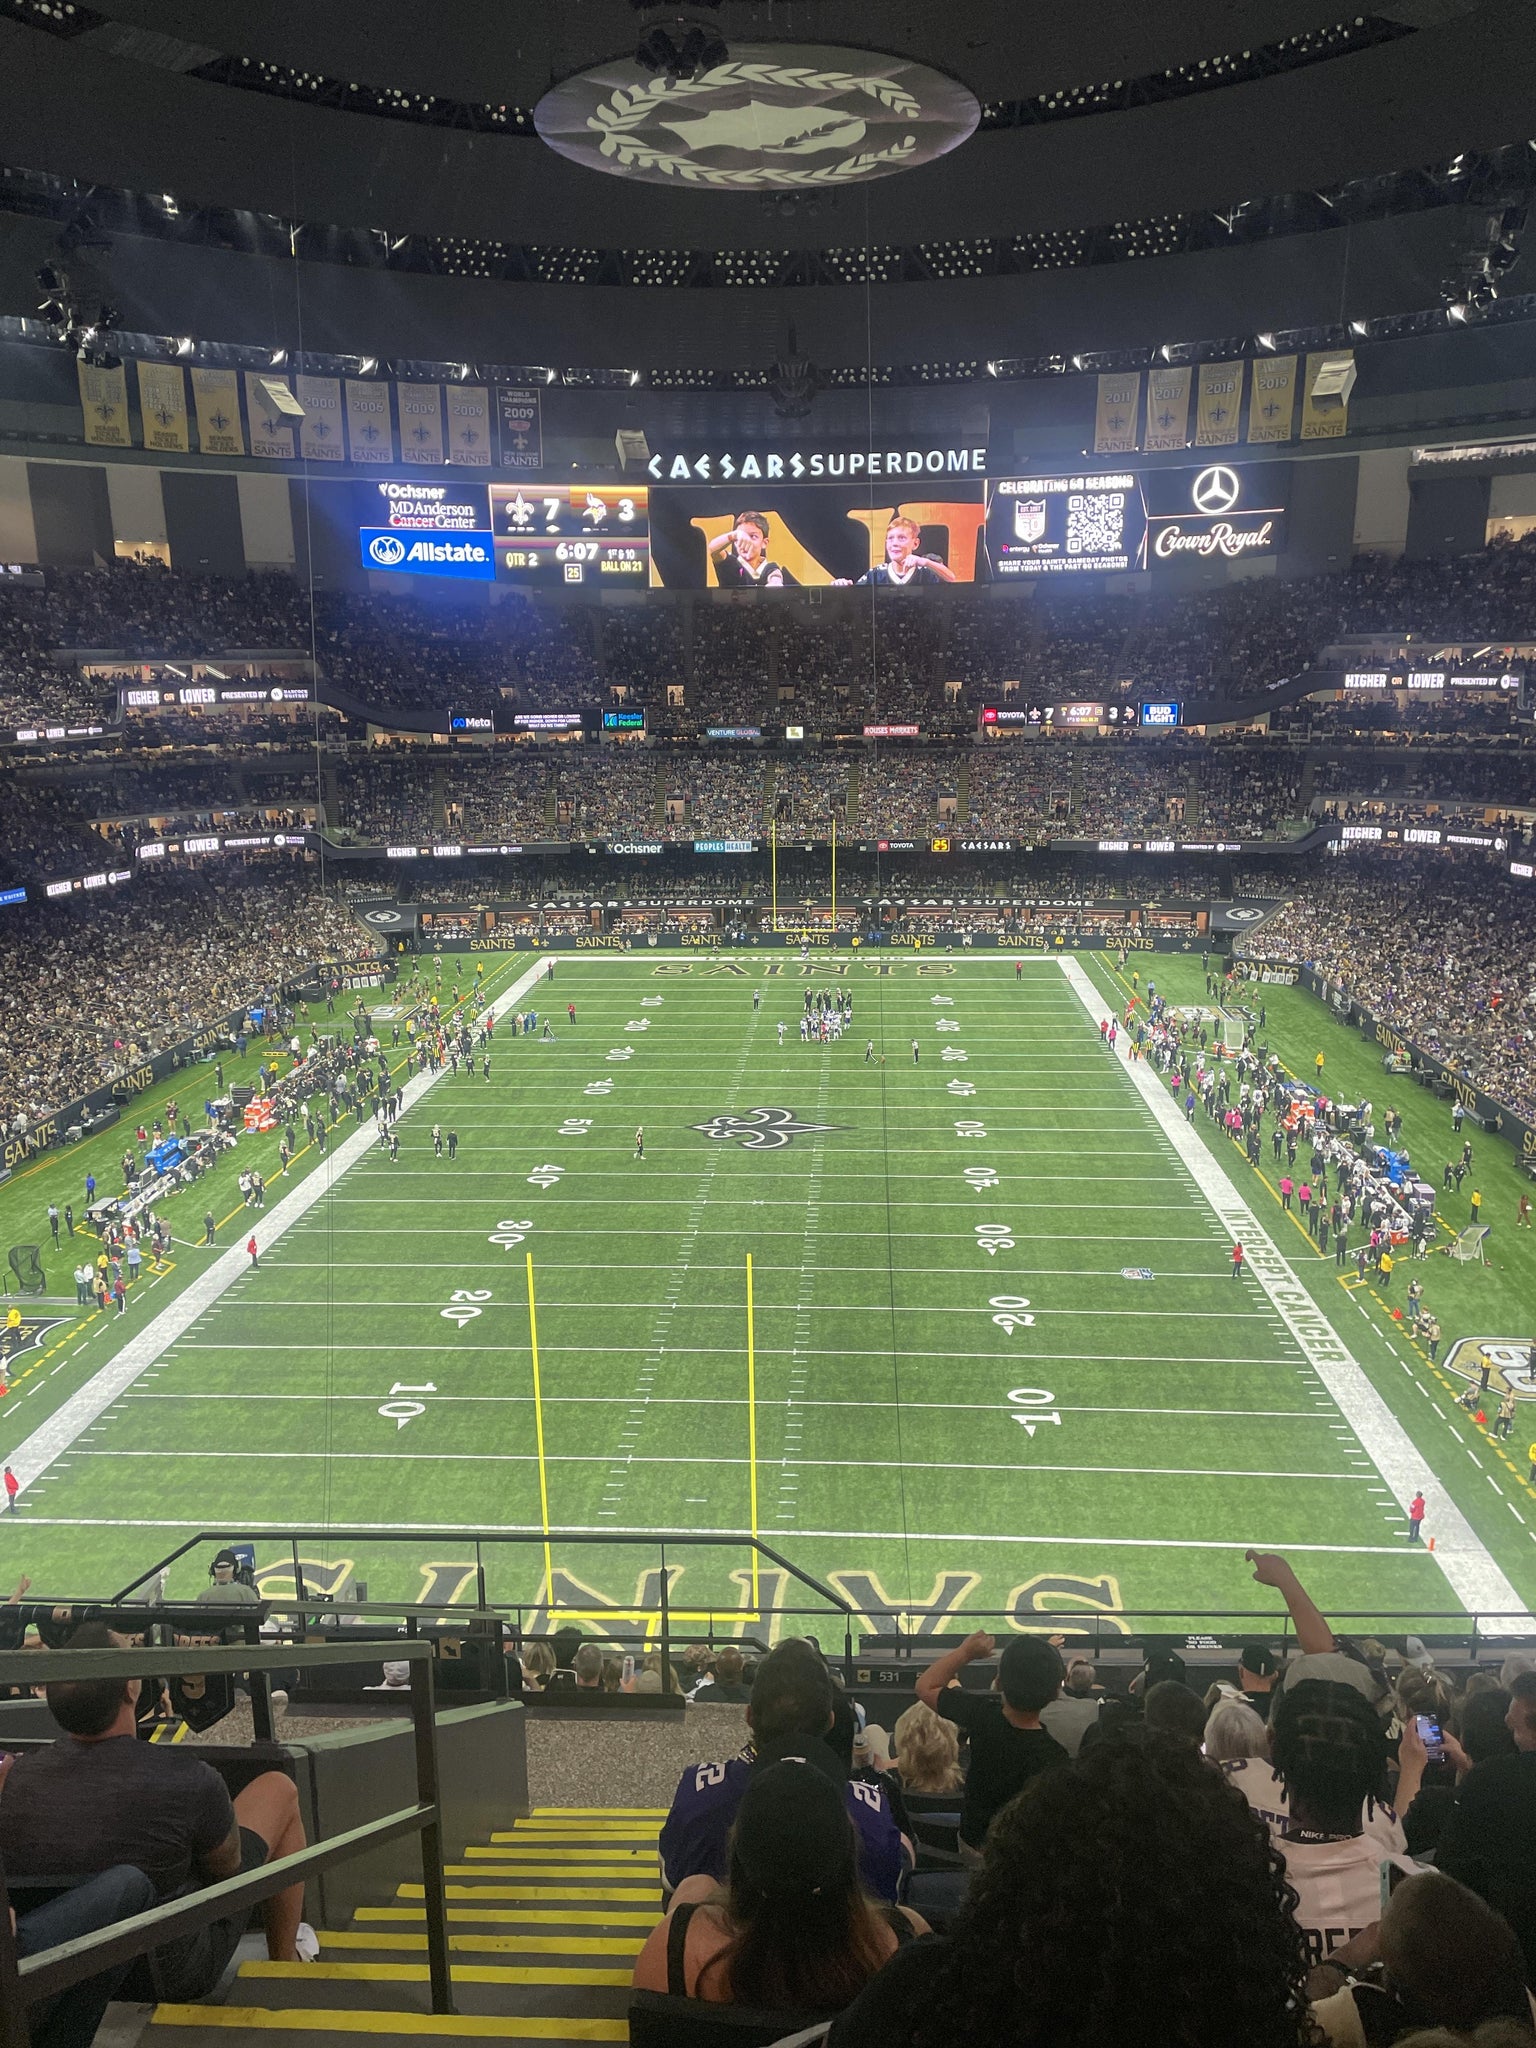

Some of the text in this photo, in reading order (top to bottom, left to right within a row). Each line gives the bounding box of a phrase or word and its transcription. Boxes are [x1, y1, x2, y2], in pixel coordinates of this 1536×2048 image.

[1206, 382, 1235, 394] 2018
[1259, 377, 1289, 390] 2019
[1105, 392, 1131, 404] 2011
[1156, 388, 1183, 400] 2017
[304, 396, 336, 409] 2000
[504, 407, 535, 419] 2009
[1250, 429, 1289, 441] SAINTS
[1304, 426, 1343, 437] SAINTS
[1147, 439, 1183, 449] SAINTS
[1198, 433, 1237, 445] SAINTS
[254, 445, 291, 457] SAINTS
[1097, 441, 1132, 451] SAINTS
[305, 448, 341, 459] SAINTS
[353, 451, 390, 461] SAINTS
[404, 452, 440, 463] SAINTS
[453, 454, 488, 464] SAINTS
[503, 456, 539, 466] SAINTS
[648, 449, 986, 479] CAESARS SUPERDOME
[999, 479, 1068, 494] CELEBRATING
[1086, 475, 1133, 490] SEASONS
[388, 484, 445, 500] Ochsner
[390, 501, 474, 516] MD Anderson
[543, 498, 634, 521] 7 3
[390, 515, 476, 529] Cancer Center
[1155, 525, 1214, 557] Crown
[555, 542, 599, 560] 6:07
[626, 549, 635, 559] 10
[506, 552, 538, 567] QTR 2
[601, 561, 642, 572] BALL ON 21
[567, 567, 579, 579] 25
[1345, 673, 1498, 688] HIGHER OR LOWER PRESENTED BY
[164, 692, 175, 701] OR
[180, 688, 215, 704] LOWER
[221, 691, 257, 700] PRESENTED
[1045, 707, 1054, 719] 7
[1070, 706, 1092, 716] 6:07
[1109, 706, 1118, 719] 3
[1150, 706, 1170, 715] BUD
[466, 717, 490, 728] Meta
[1146, 714, 1175, 723] LIGHT
[865, 726, 918, 735] ROUSES MARKETS
[1342, 827, 1382, 839] HIGHER
[1404, 829, 1440, 843] LOWER
[1447, 835, 1483, 846] PRESENTED
[1484, 838, 1492, 846] BY
[169, 844, 179, 852] OR
[184, 838, 219, 853] LOWER
[224, 838, 260, 847] PRESENTED
[261, 837, 270, 845] BY
[614, 843, 662, 854] Ochsner
[695, 843, 751, 851] PEOPLES HEALTH
[934, 840, 948, 851] 25
[961, 842, 1011, 850] CAESARS
[1020, 839, 1047, 847] SAINTS
[1099, 842, 1129, 851] HIGHER
[1146, 842, 1175, 852] LOWER
[387, 847, 417, 857] HIGHER
[433, 846, 461, 856] LOWER
[83, 874, 107, 888] LOWER
[528, 899, 755, 908] CAESARS SUPERDOME
[862, 898, 1095, 907] CAESARS SUPERDOME
[471, 939, 516, 950] SAINTS
[576, 936, 620, 947] SAINTS
[786, 934, 830, 945] SANTS
[891, 934, 935, 945] SAINTS
[998, 935, 1044, 947] SAINTS
[1106, 937, 1153, 949] SAINTS
[318, 961, 380, 977] SAINTS
[650, 962, 957, 977] SAINTS
[605, 1047, 635, 1061] 30
[940, 1048, 968, 1062] 30
[583, 1080, 614, 1095] 40
[946, 1082, 976, 1097] 40
[557, 1118, 594, 1135] 50
[954, 1120, 987, 1138] 50
[5, 1119, 57, 1168] SANTS
[526, 1164, 565, 1184] 40
[963, 1167, 1000, 1187] 40
[488, 1220, 533, 1244] 30
[974, 1224, 1015, 1249] 30
[1220, 1207, 1350, 1365] INTERCEPT CANCER
[440, 1289, 492, 1319] 20
[989, 1295, 1036, 1327] 20
[378, 1382, 438, 1418] 10
[1006, 1388, 1062, 1426] 10
[879, 1672, 900, 1682] 531
[1300, 1830, 1324, 1840] NIKE
